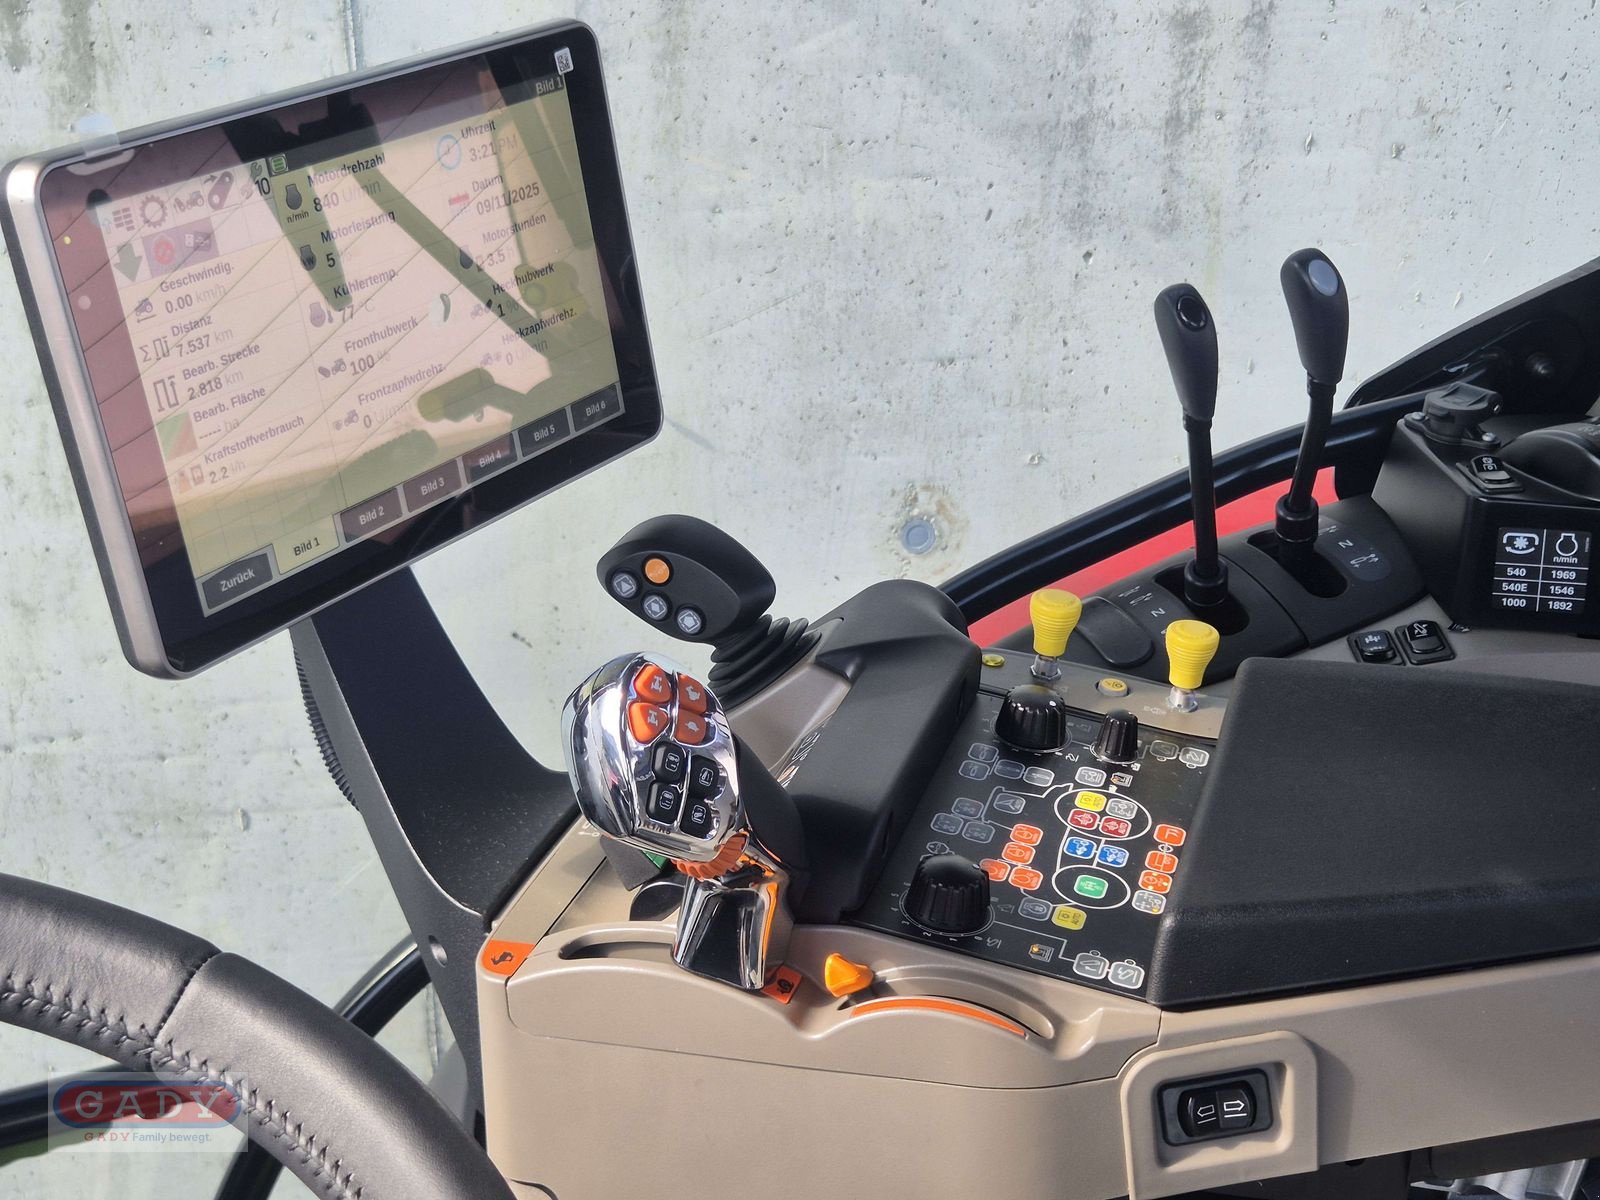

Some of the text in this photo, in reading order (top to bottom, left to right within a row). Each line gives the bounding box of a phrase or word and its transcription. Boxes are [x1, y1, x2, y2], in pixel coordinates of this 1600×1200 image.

[535, 80, 555, 95] Bild
[461, 120, 496, 139] Uhrzeit
[469, 142, 496, 162] 3:21
[307, 152, 385, 187] Motordrehzahl
[255, 177, 271, 196] 10
[471, 174, 503, 192] Datum
[313, 192, 339, 212] 840
[476, 182, 540, 216] 09/11/2025
[287, 211, 310, 223] n/min
[320, 211, 396, 243] Motorleistung
[482, 213, 546, 244] Motorstunden
[326, 253, 335, 268] 5
[160, 259, 235, 294] Geschwindig.
[333, 269, 400, 299] Kühlertemp.
[492, 263, 555, 295] Heckhubwerk
[165, 294, 193, 314] 0.00
[171, 315, 213, 337] Distanz
[344, 316, 418, 352] Fronthubwerk
[176, 335, 210, 357] 7.537
[182, 343, 260, 381] Bearb. Strecke
[350, 354, 375, 376] 100
[187, 377, 223, 400] 2.818
[193, 386, 266, 423] Bearb. Fläche
[585, 404, 600, 416] Bild
[204, 415, 305, 465] Kraftstoffverbrauch
[533, 428, 549, 442] Bild
[479, 454, 495, 468] Bild
[209, 466, 230, 484] 2.2
[420, 480, 438, 496] Bild
[359, 510, 378, 526] Bild
[293, 541, 312, 557] Bild
[1553, 556, 1578, 564] n/min
[219, 568, 256, 593] Zurück
[1507, 567, 1526, 577] 540
[1551, 570, 1576, 580] 1969
[1502, 582, 1528, 592] 540E
[1549, 585, 1574, 595] 1546
[1501, 598, 1526, 607] 1000
[1548, 601, 1573, 611] 1892
